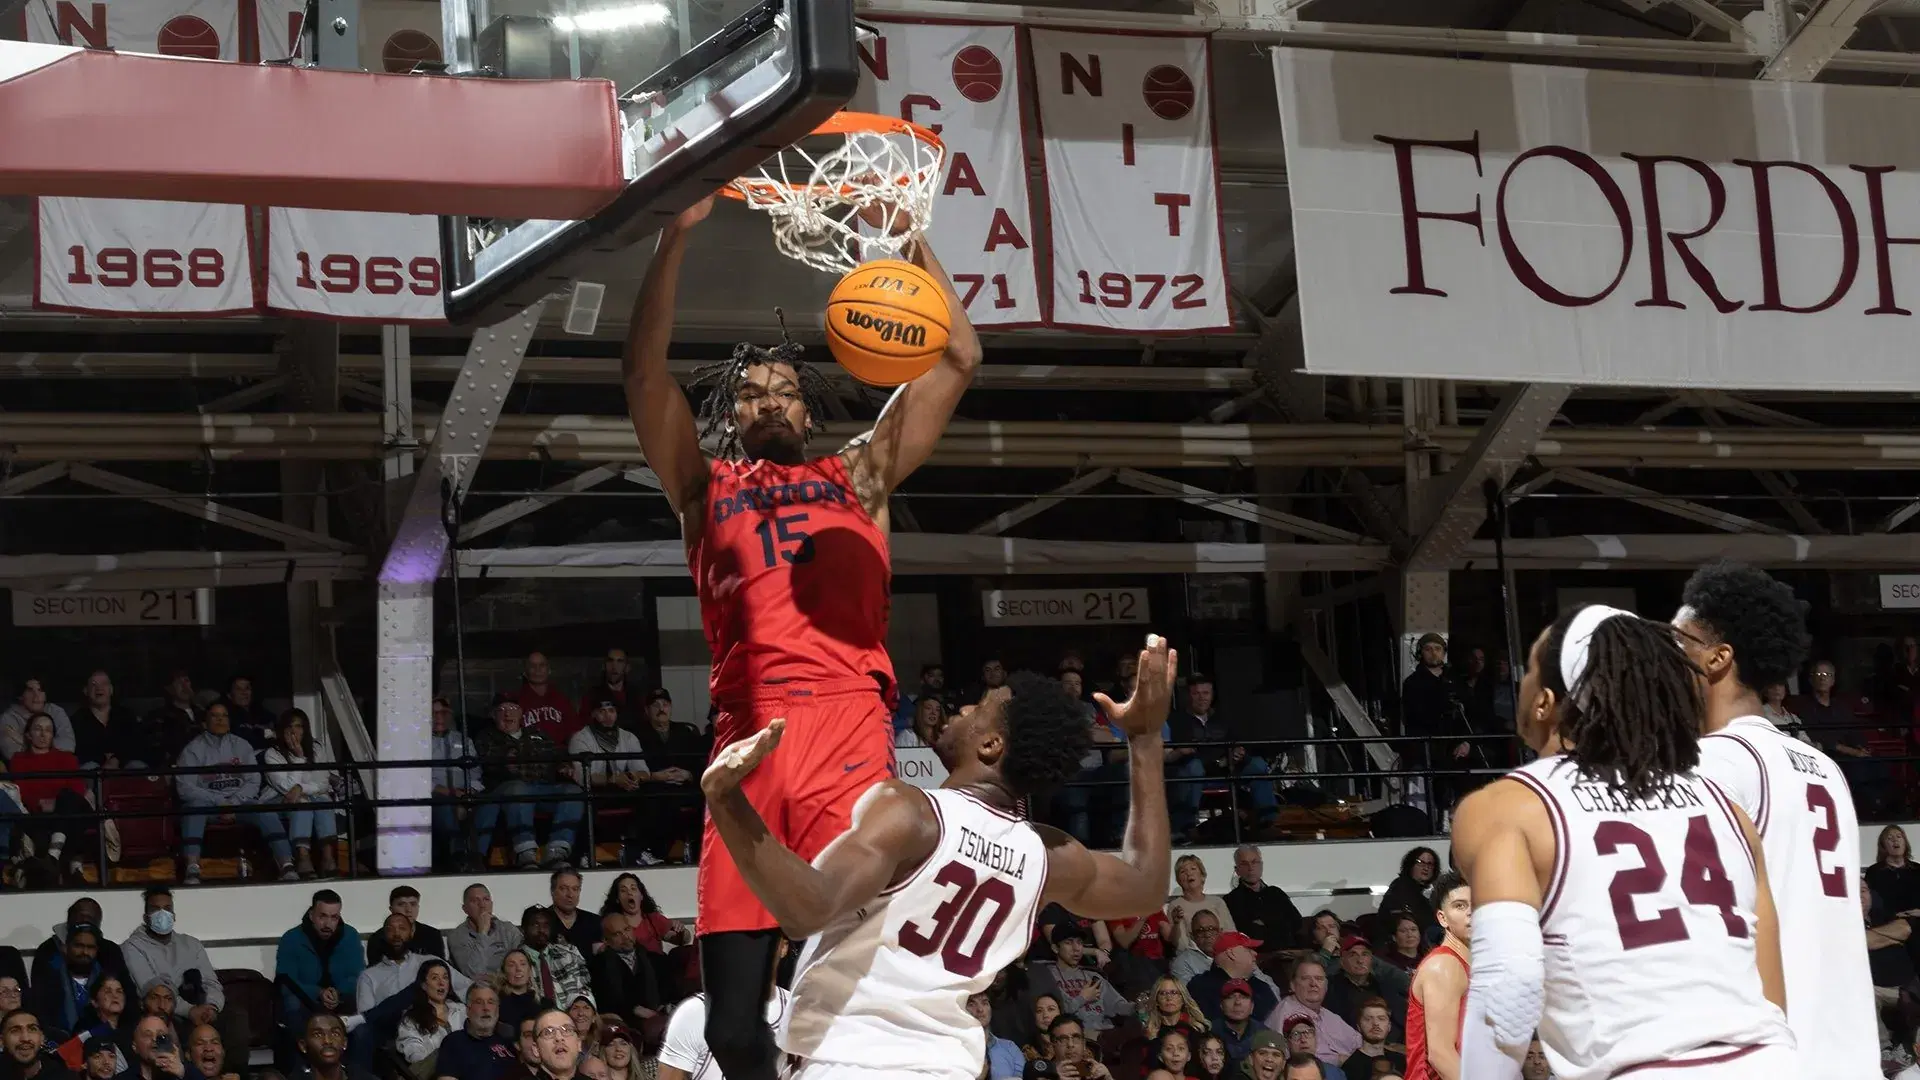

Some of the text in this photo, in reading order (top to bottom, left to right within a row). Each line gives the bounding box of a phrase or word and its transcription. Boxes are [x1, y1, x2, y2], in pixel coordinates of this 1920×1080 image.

[1373, 129, 1920, 316] FORDH
[67, 245, 224, 288] 1968
[296, 251, 441, 296] 1969
[1077, 270, 1207, 310] 1972
[846, 308, 927, 347] Wilson
[714, 480, 847, 525] DAYTON
[755, 513, 815, 568] 15
[32, 590, 198, 620] SECTION 211
[997, 592, 1137, 620] SECTION 212
[957, 825, 1027, 880] TSIMBILA
[1806, 782, 1849, 899] 2
[1593, 814, 1750, 951] 24
[898, 859, 1017, 979] 30
